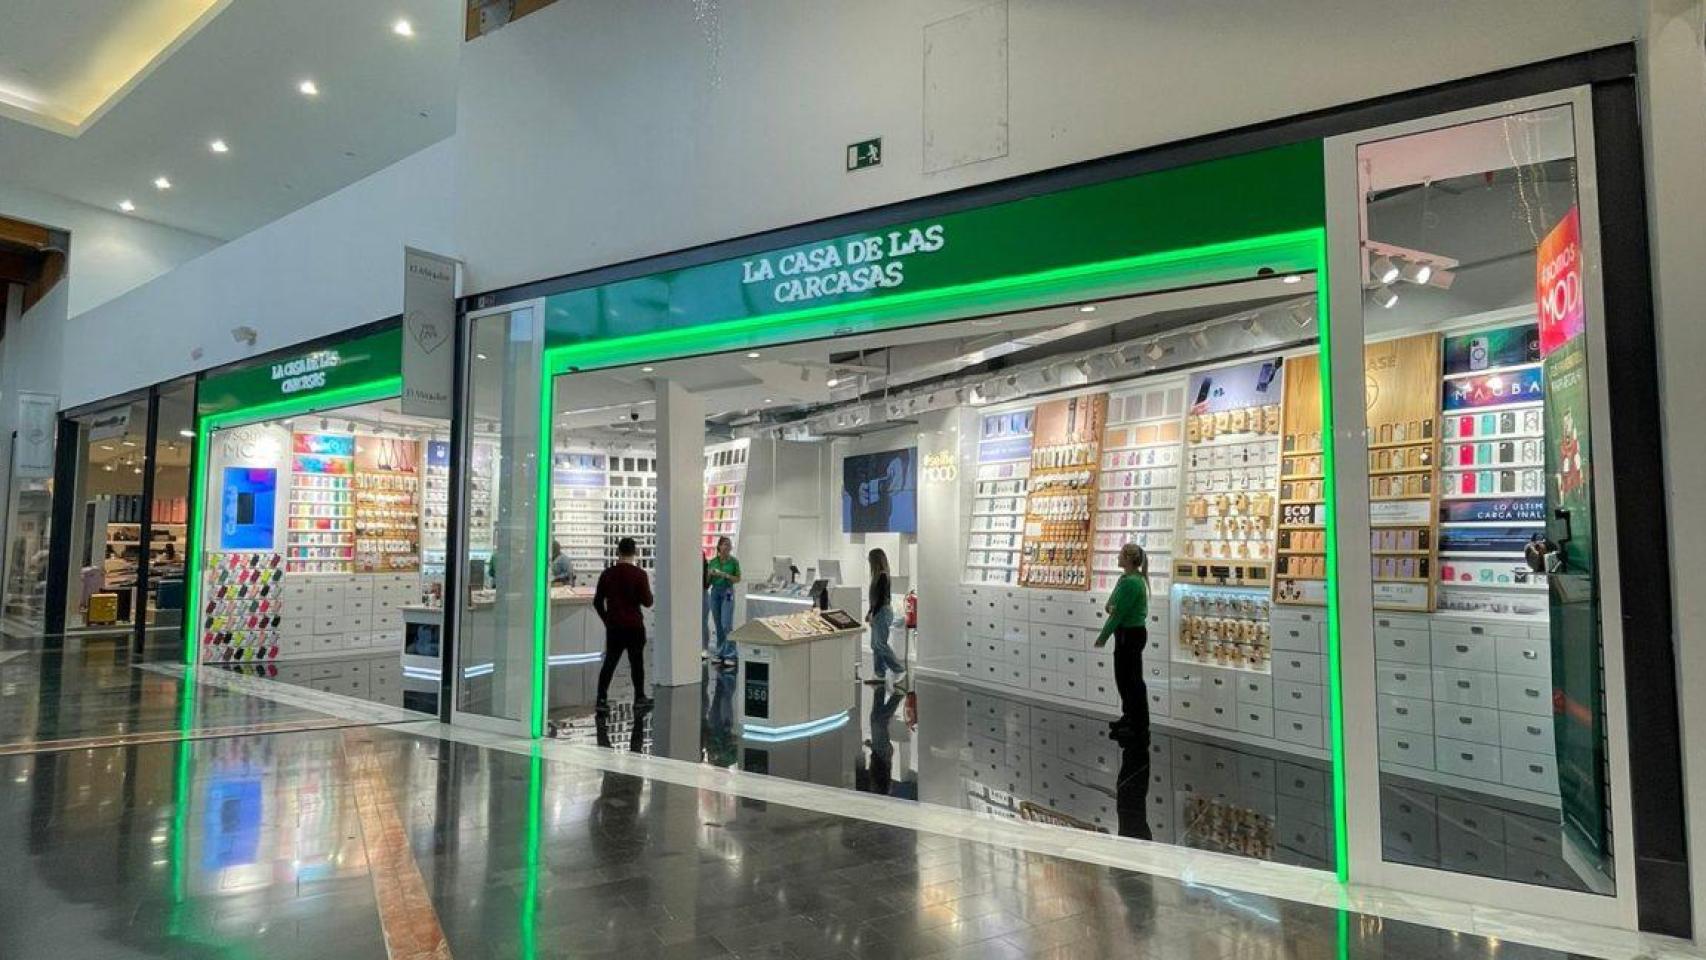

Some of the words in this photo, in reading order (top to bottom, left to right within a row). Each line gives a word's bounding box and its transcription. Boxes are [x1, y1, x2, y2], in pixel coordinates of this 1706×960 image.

[742, 259, 775, 283] LA
[779, 245, 842, 275] CASA
[847, 236, 883, 264] DE
[888, 224, 944, 256] LAS
[774, 261, 904, 302] CARCASAS
[1541, 270, 1582, 332] MOD
[1284, 504, 1311, 517] ECO
